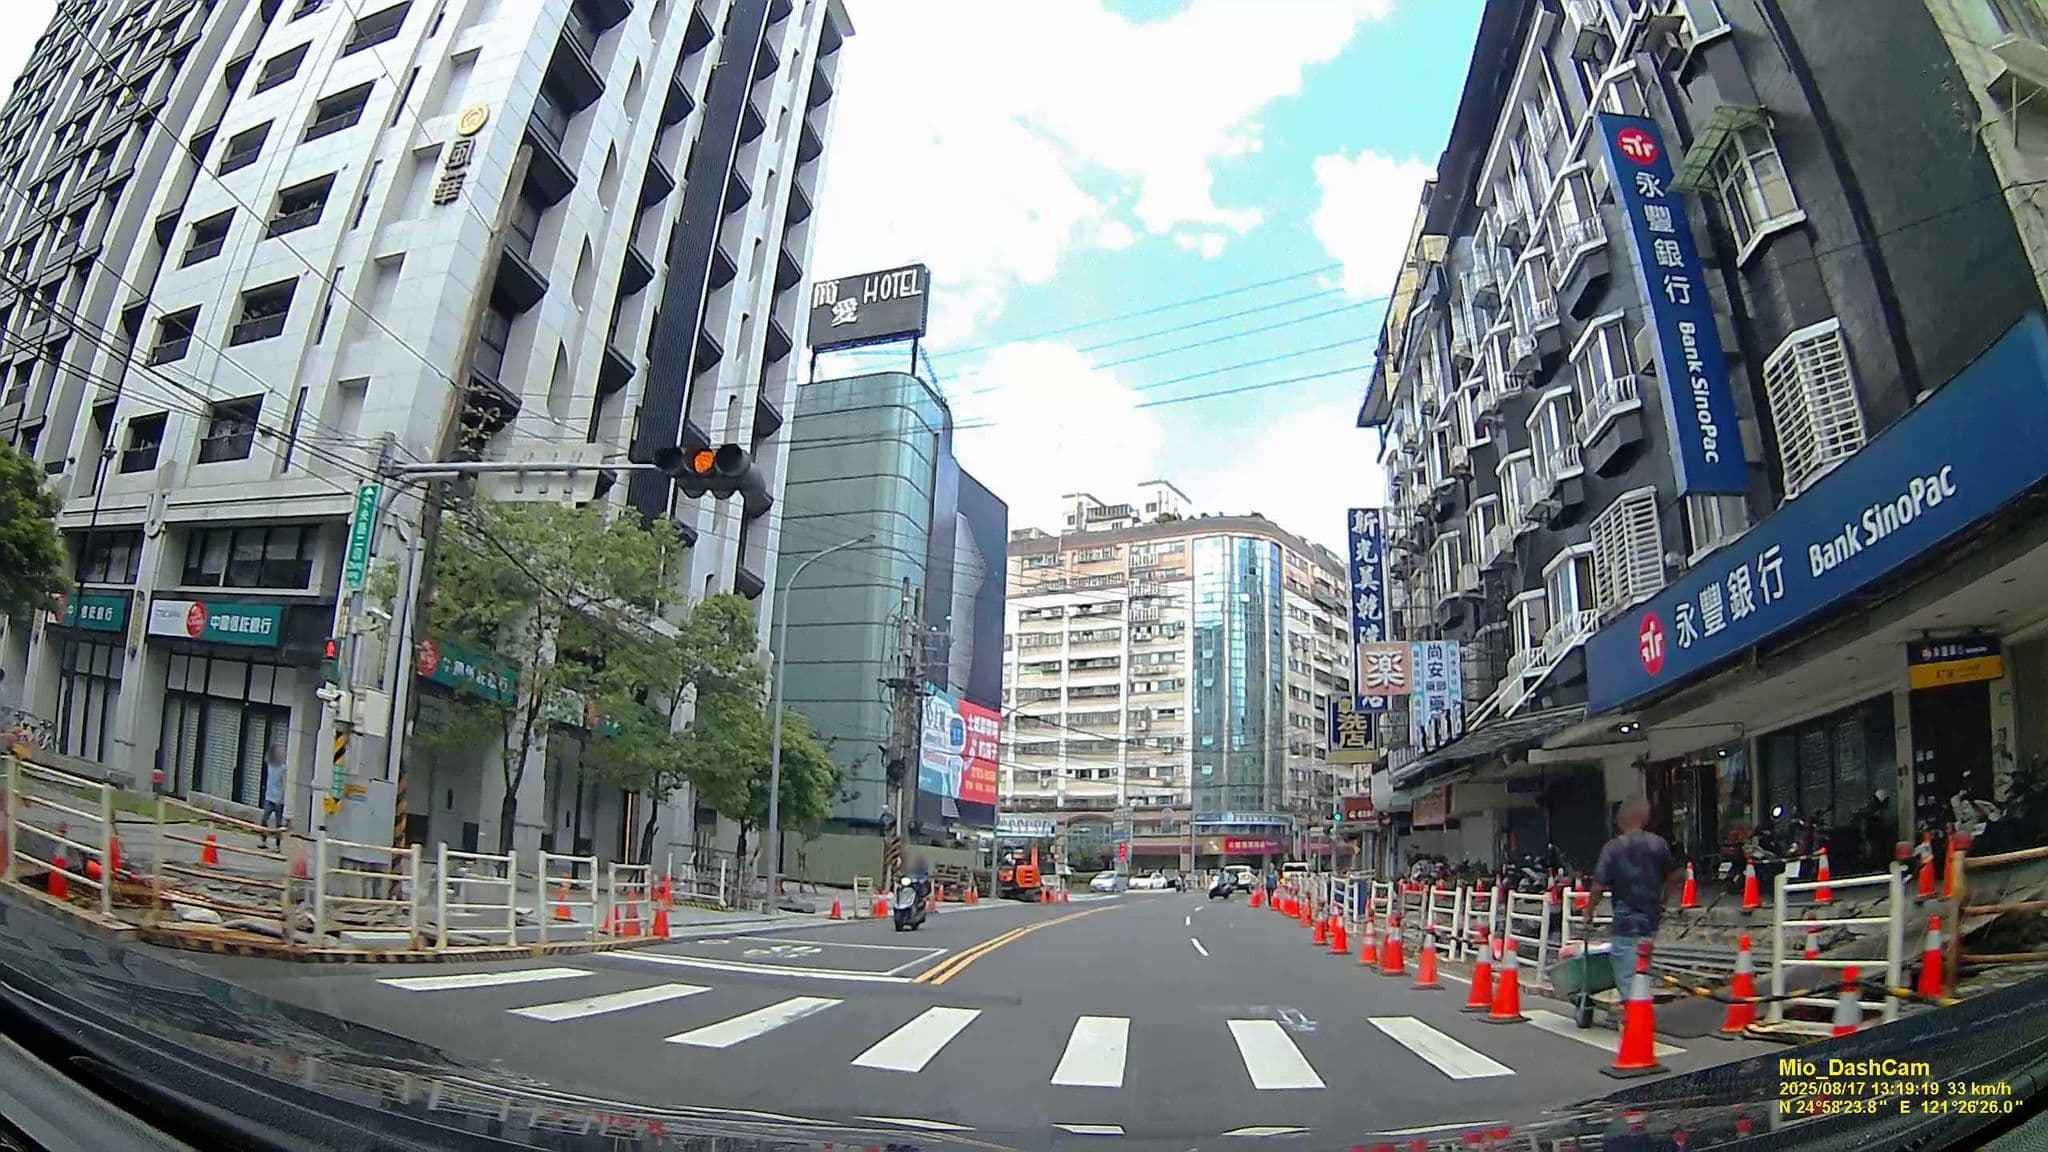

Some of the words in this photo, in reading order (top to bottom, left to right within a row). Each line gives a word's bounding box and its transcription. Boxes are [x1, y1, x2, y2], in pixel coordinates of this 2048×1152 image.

[1634, 171, 1691, 304] 永豐銀行
[863, 269, 923, 305] HOTEL
[1678, 320, 1705, 374] Bank
[1690, 375, 1720, 464] SinoPac
[1807, 522, 1863, 579] Bank
[1861, 464, 1957, 547] SinoPac
[210, 613, 272, 635] 中國信託銀行
[1674, 543, 1785, 649] 永豐銀行
